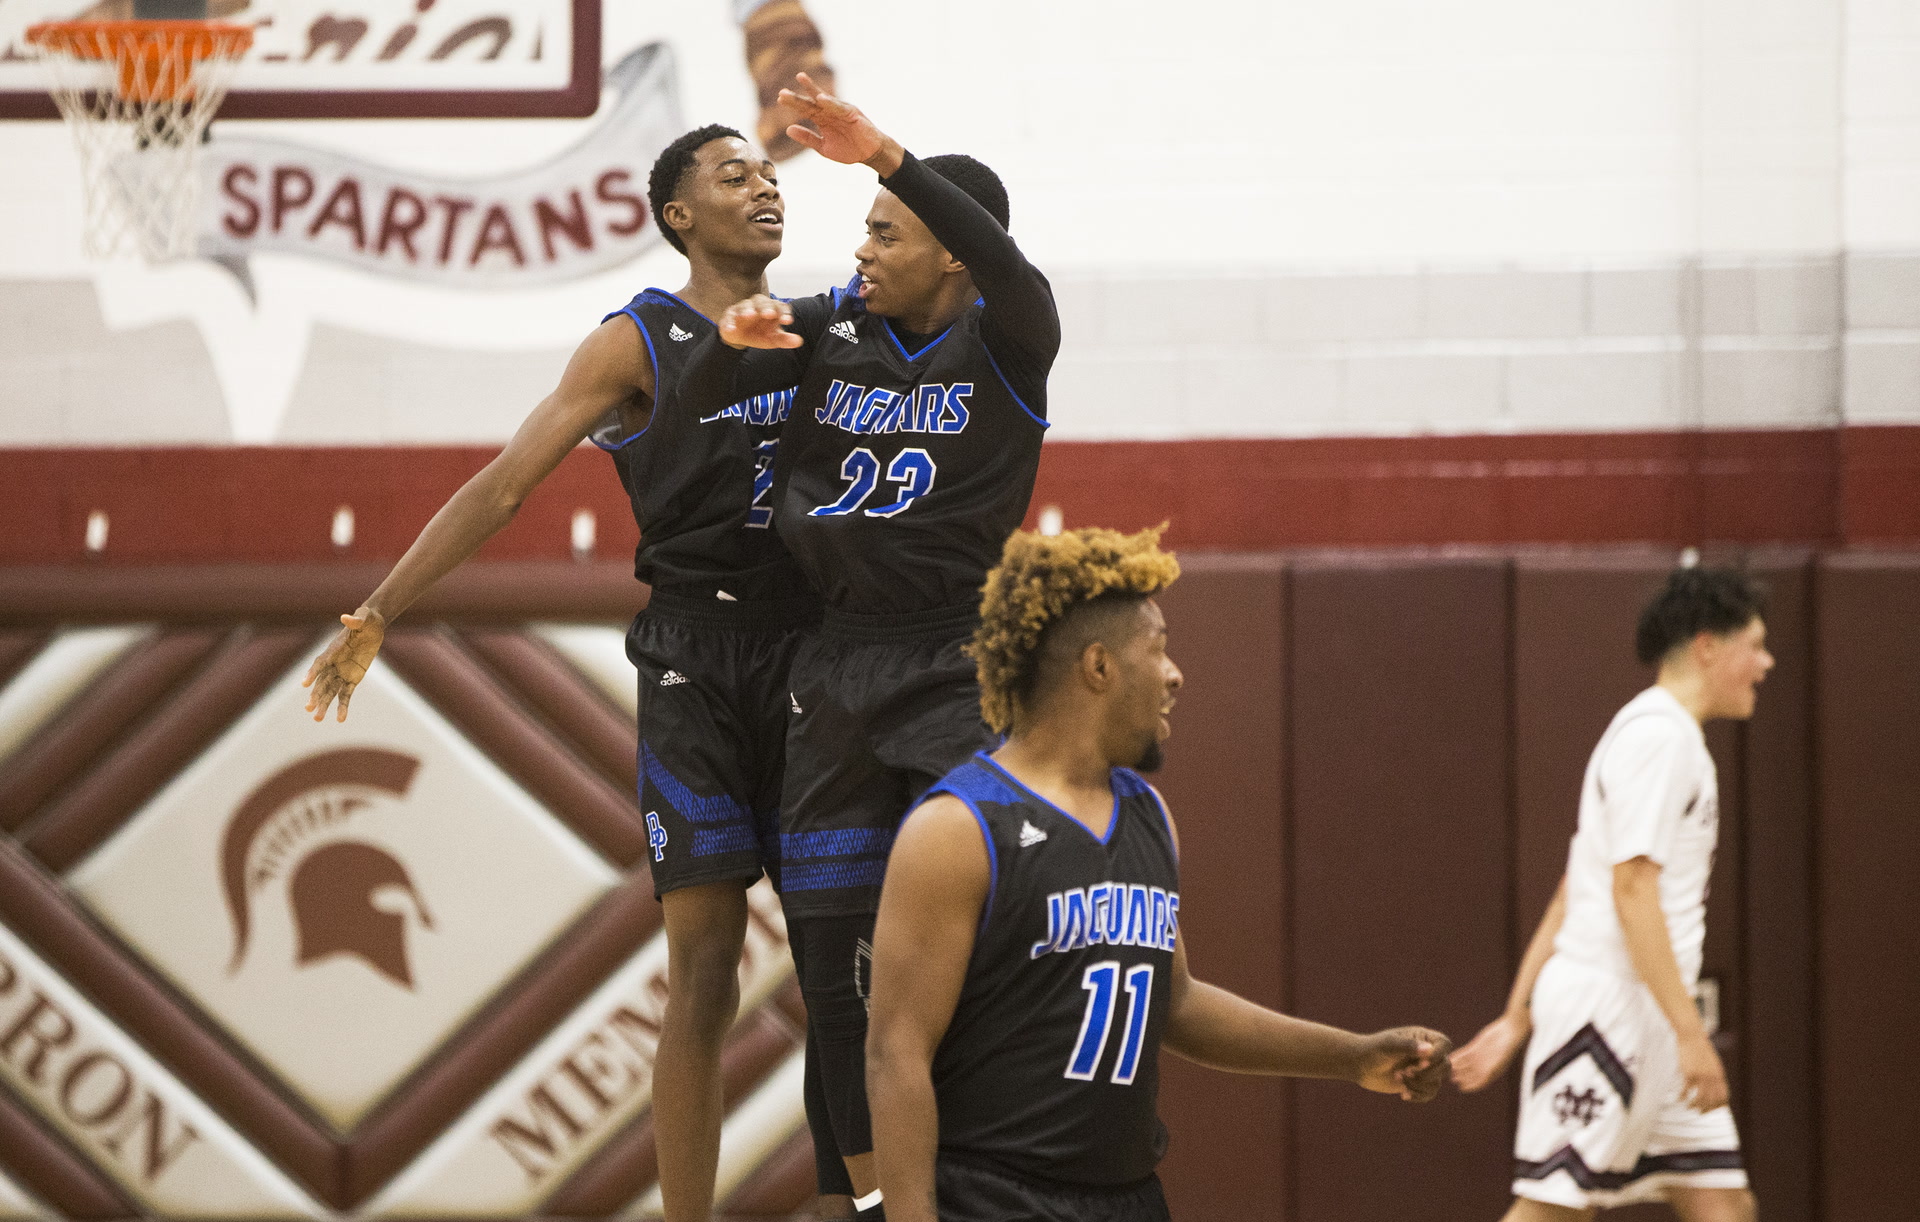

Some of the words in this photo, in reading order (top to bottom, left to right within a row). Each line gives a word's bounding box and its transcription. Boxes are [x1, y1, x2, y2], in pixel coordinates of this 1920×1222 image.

[220, 162, 649, 268] SPARTANS
[829, 325, 859, 344] adidas
[1030, 881, 1180, 960] JAGUARS
[1063, 960, 1154, 1085] 11
